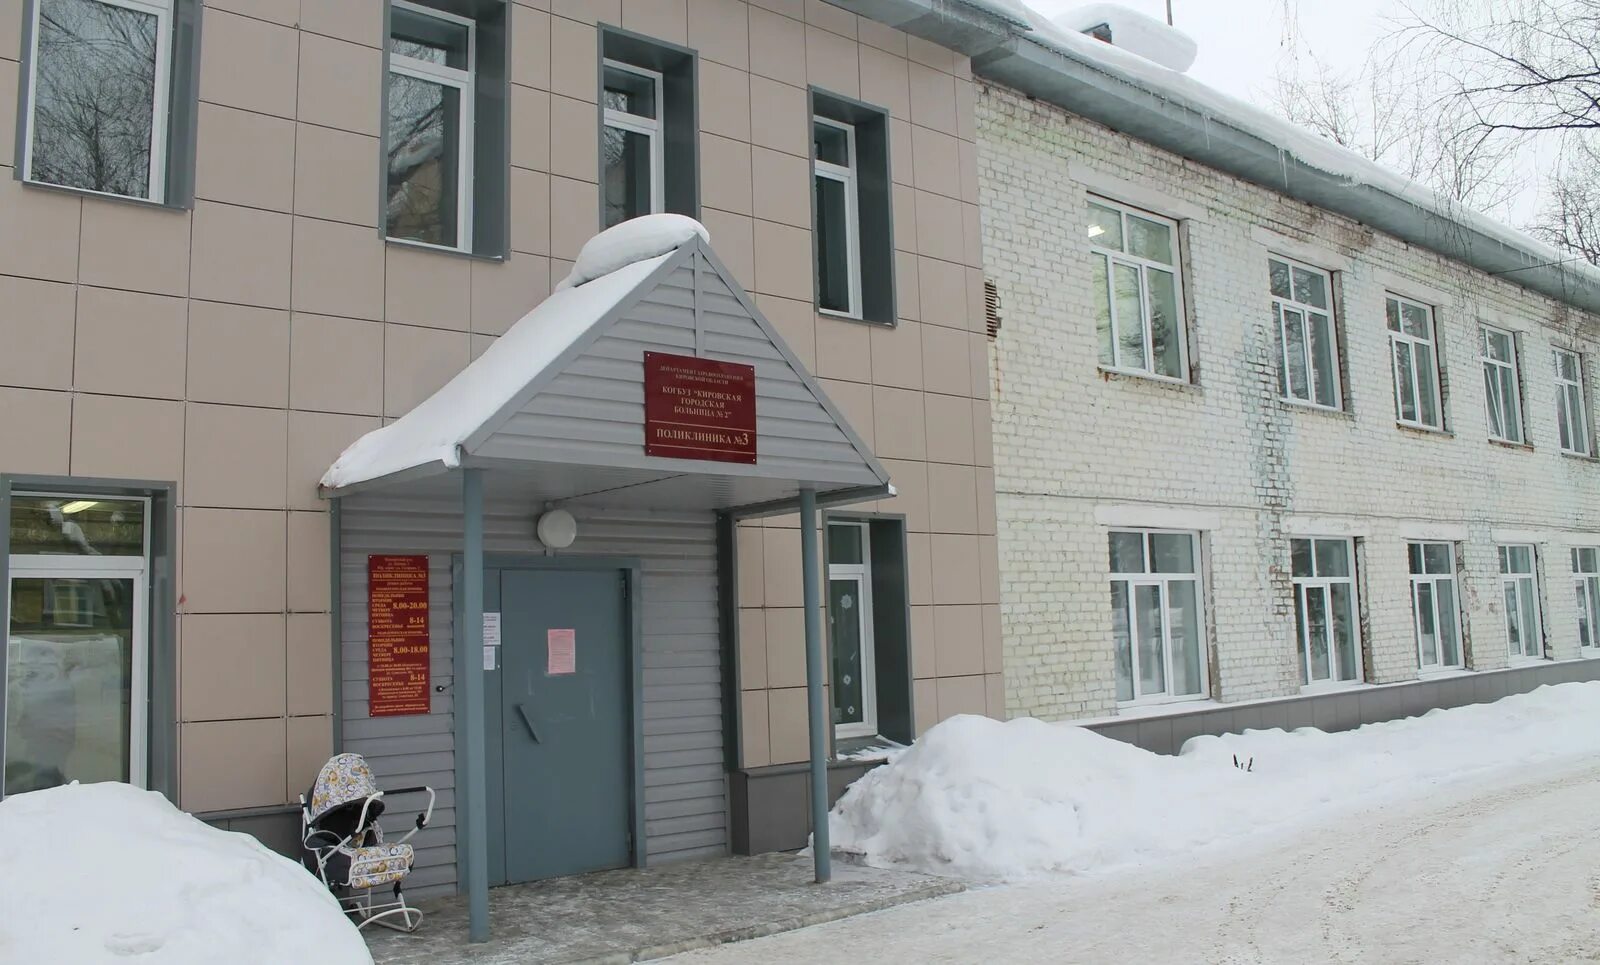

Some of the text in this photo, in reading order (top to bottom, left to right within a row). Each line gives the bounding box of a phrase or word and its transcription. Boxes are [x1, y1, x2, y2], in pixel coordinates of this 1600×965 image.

[662, 386, 742, 402] КОГБУЗ "КИРОВСКАЯ
[681, 397, 725, 409] ГОРОДСКАЯ
[674, 406, 715, 417] БОЛЬНИЦА
[656, 428, 749, 446] ПОЛИКЛИНИКА №3
[409, 616, 424, 624] 8-14
[393, 646, 428, 654] 8.00-18.00
[410, 673, 425, 681] 8-14
